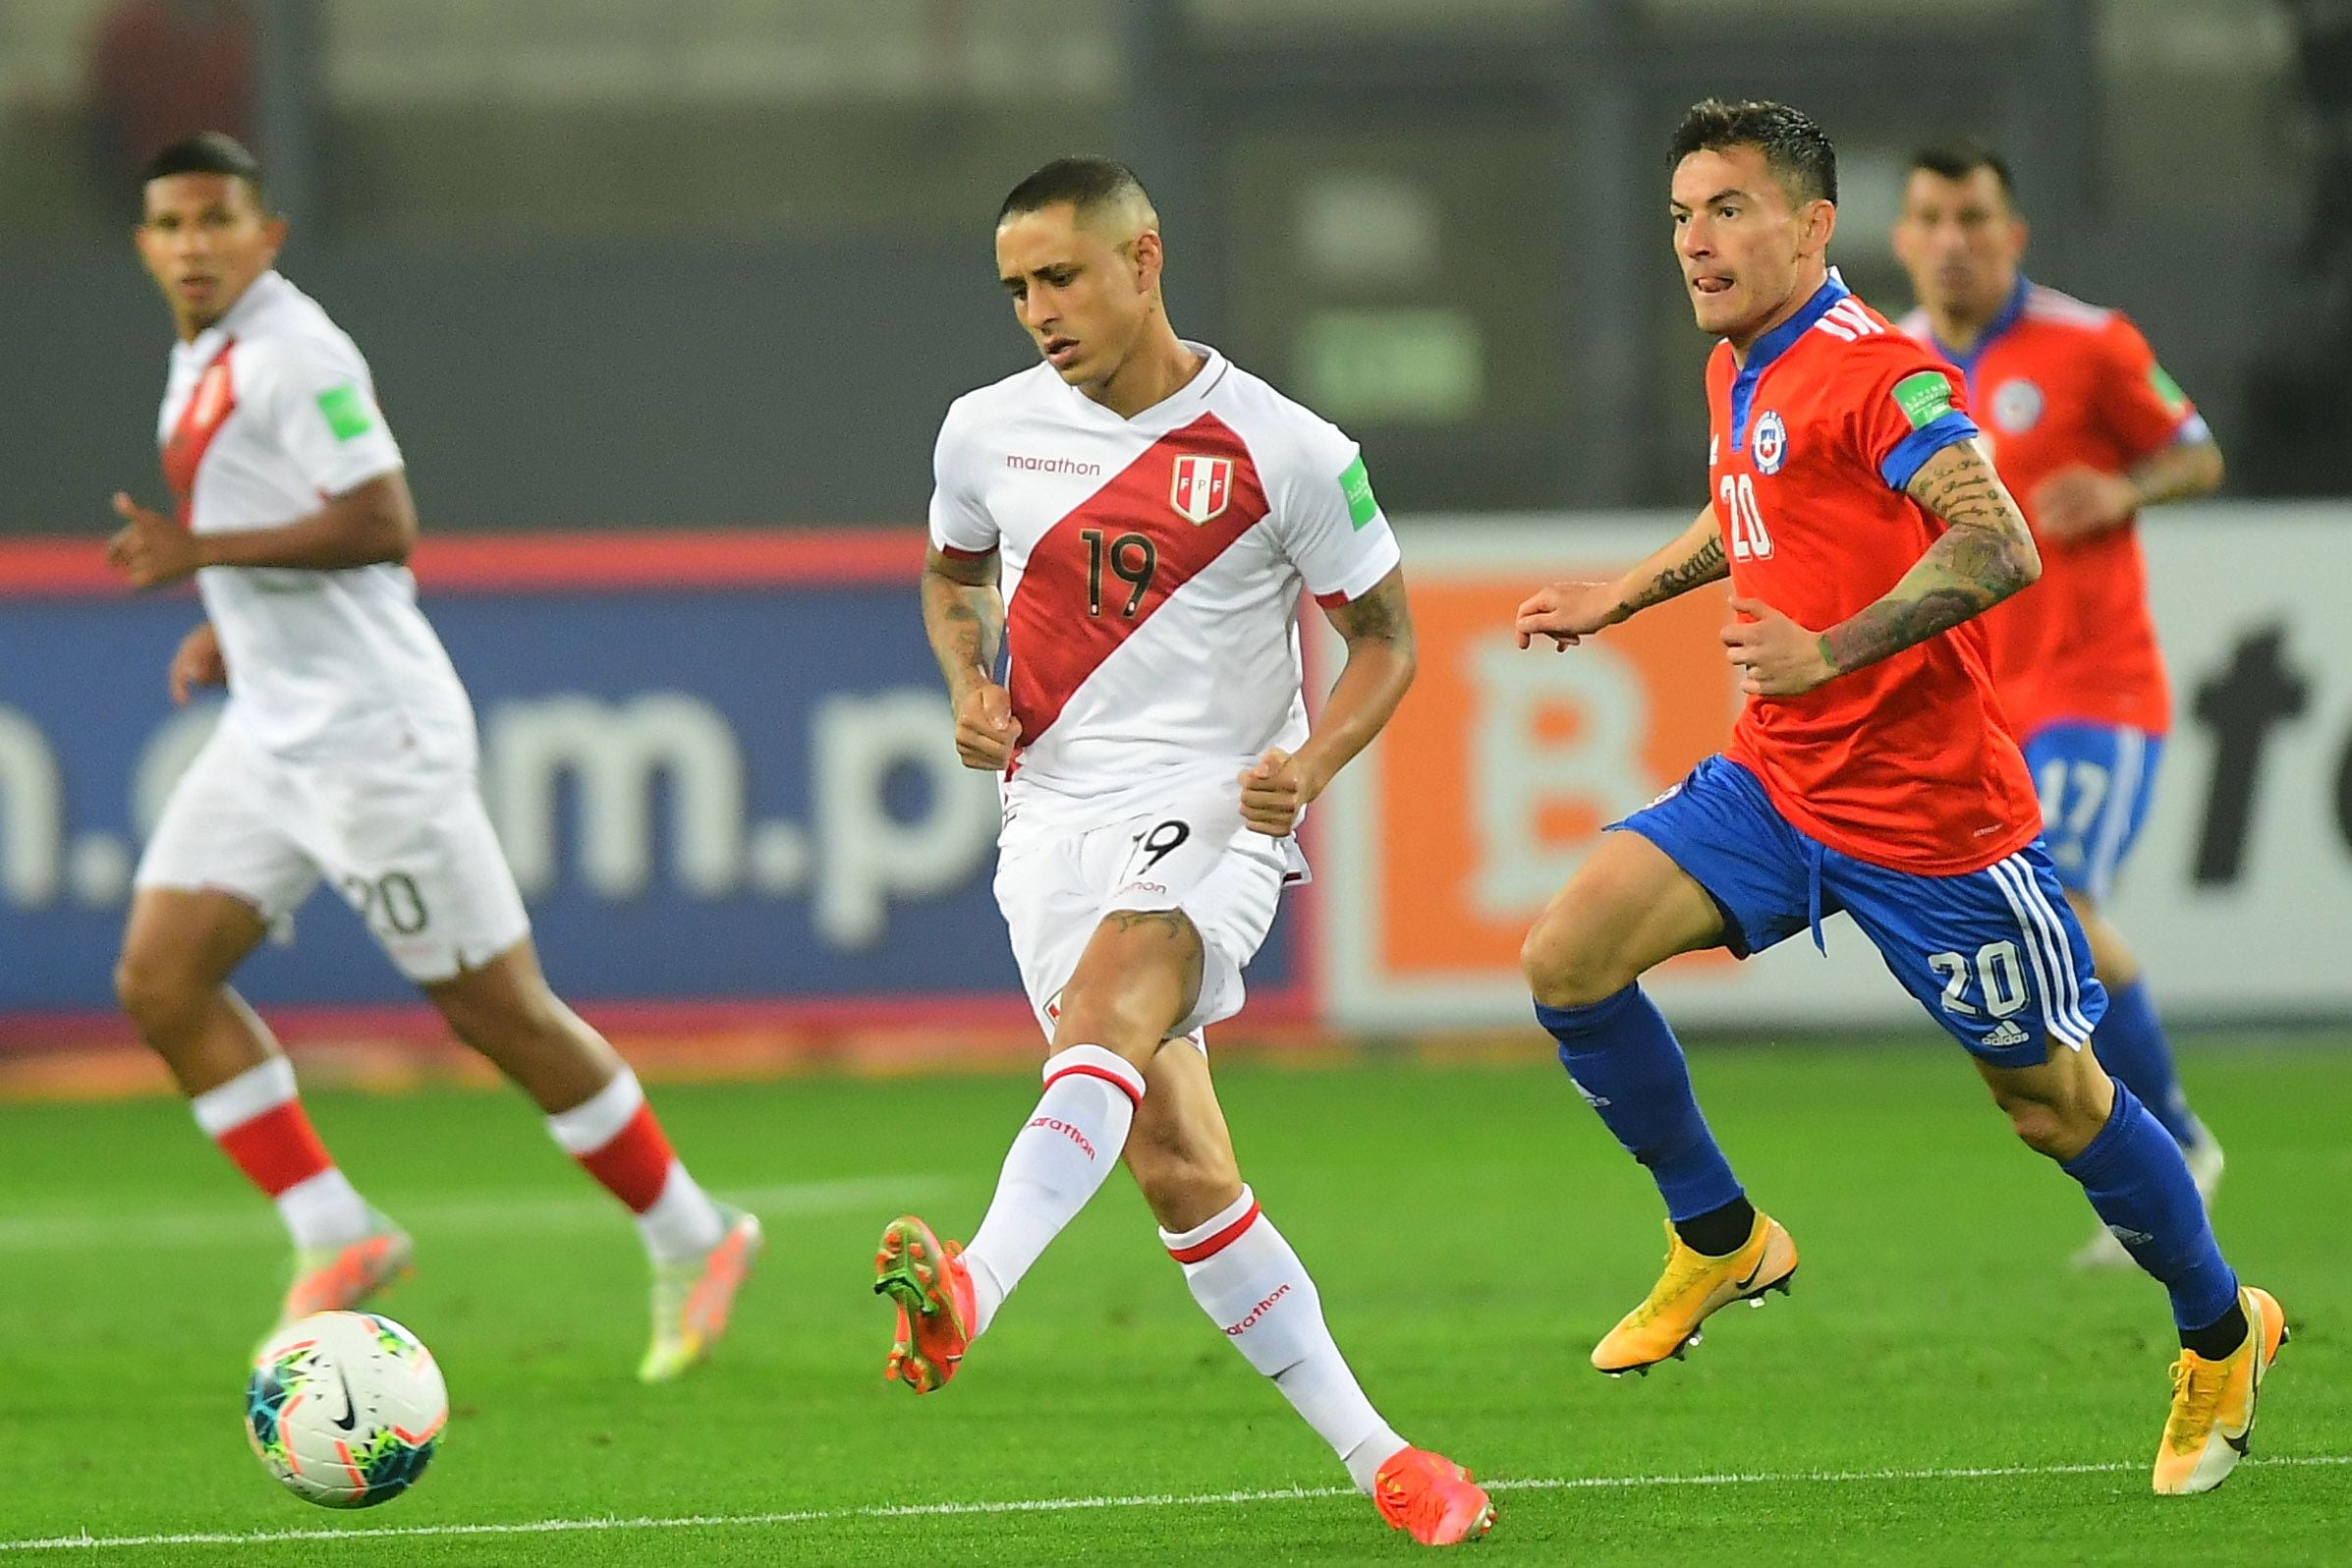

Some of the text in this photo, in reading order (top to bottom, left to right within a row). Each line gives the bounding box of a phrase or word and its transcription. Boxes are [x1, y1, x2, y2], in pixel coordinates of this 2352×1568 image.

[1006, 455, 1100, 476] marathon
[1720, 473, 1775, 563] 20
[1080, 528, 1157, 619] 19
[1928, 940, 2030, 1019] 20
[1982, 1032, 2030, 1046] adidas
[1026, 1117, 1095, 1161] arathon
[1222, 1284, 1290, 1336] arathon
